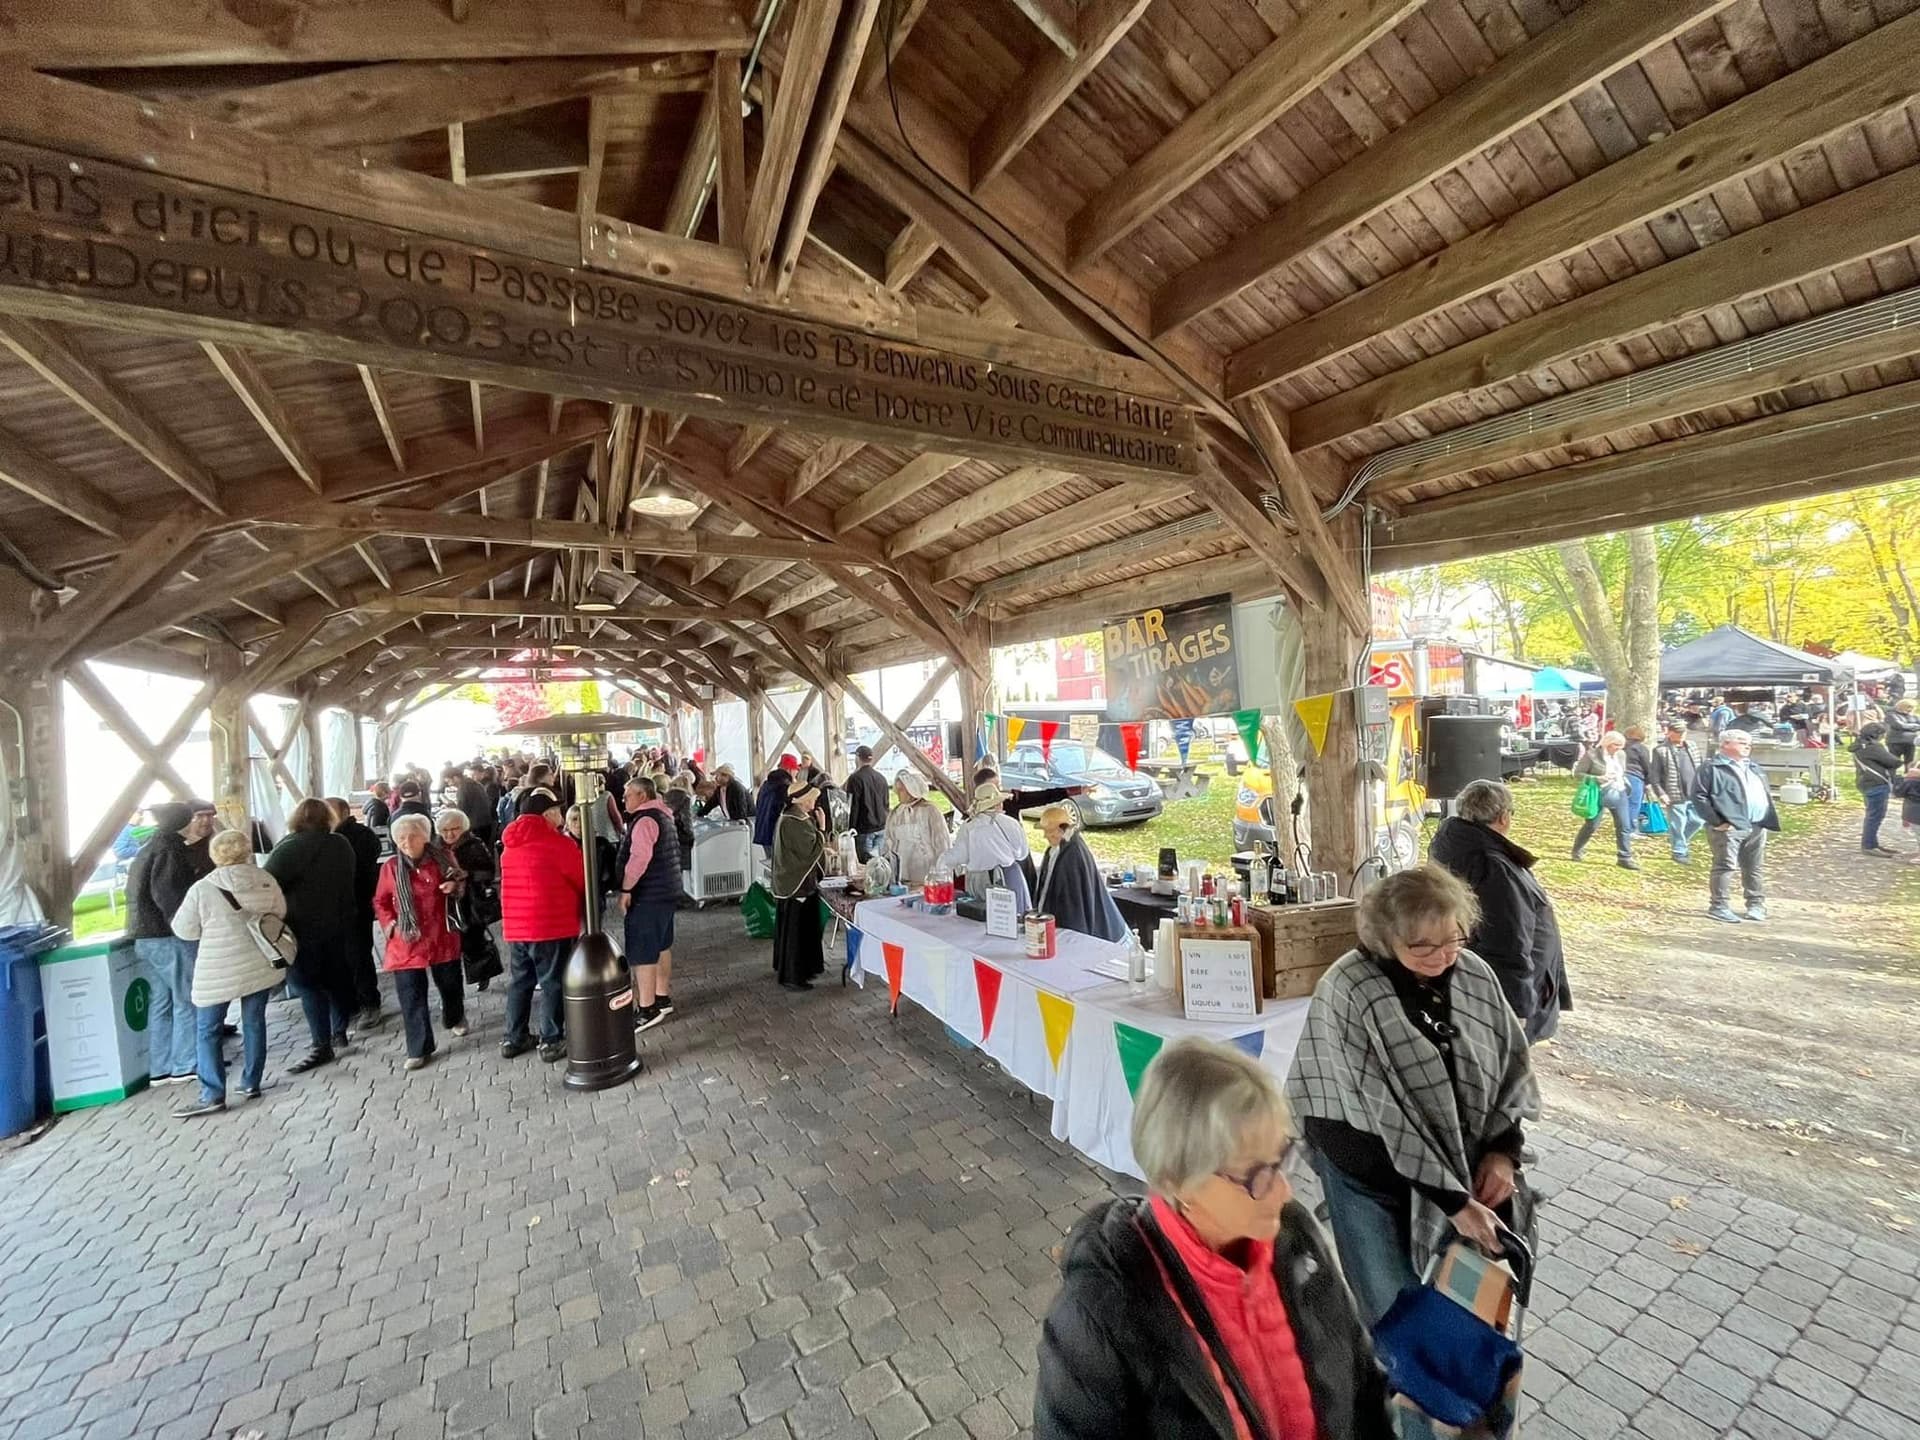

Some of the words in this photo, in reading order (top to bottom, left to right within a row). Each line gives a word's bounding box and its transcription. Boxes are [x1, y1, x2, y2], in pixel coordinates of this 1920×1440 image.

[289, 223, 358, 270] ou
[384, 246, 445, 285] de
[772, 323, 818, 361] les
[829, 334, 977, 392] Bienvenus
[1046, 383, 1106, 419] cette
[1115, 395, 1173, 431] Halle
[828, 384, 860, 412] de
[962, 402, 1011, 438] Vie
[1103, 608, 1168, 661] BAR
[1128, 623, 1231, 679] TIRAGES
[1191, 999, 1222, 1007] LIQUEUR
